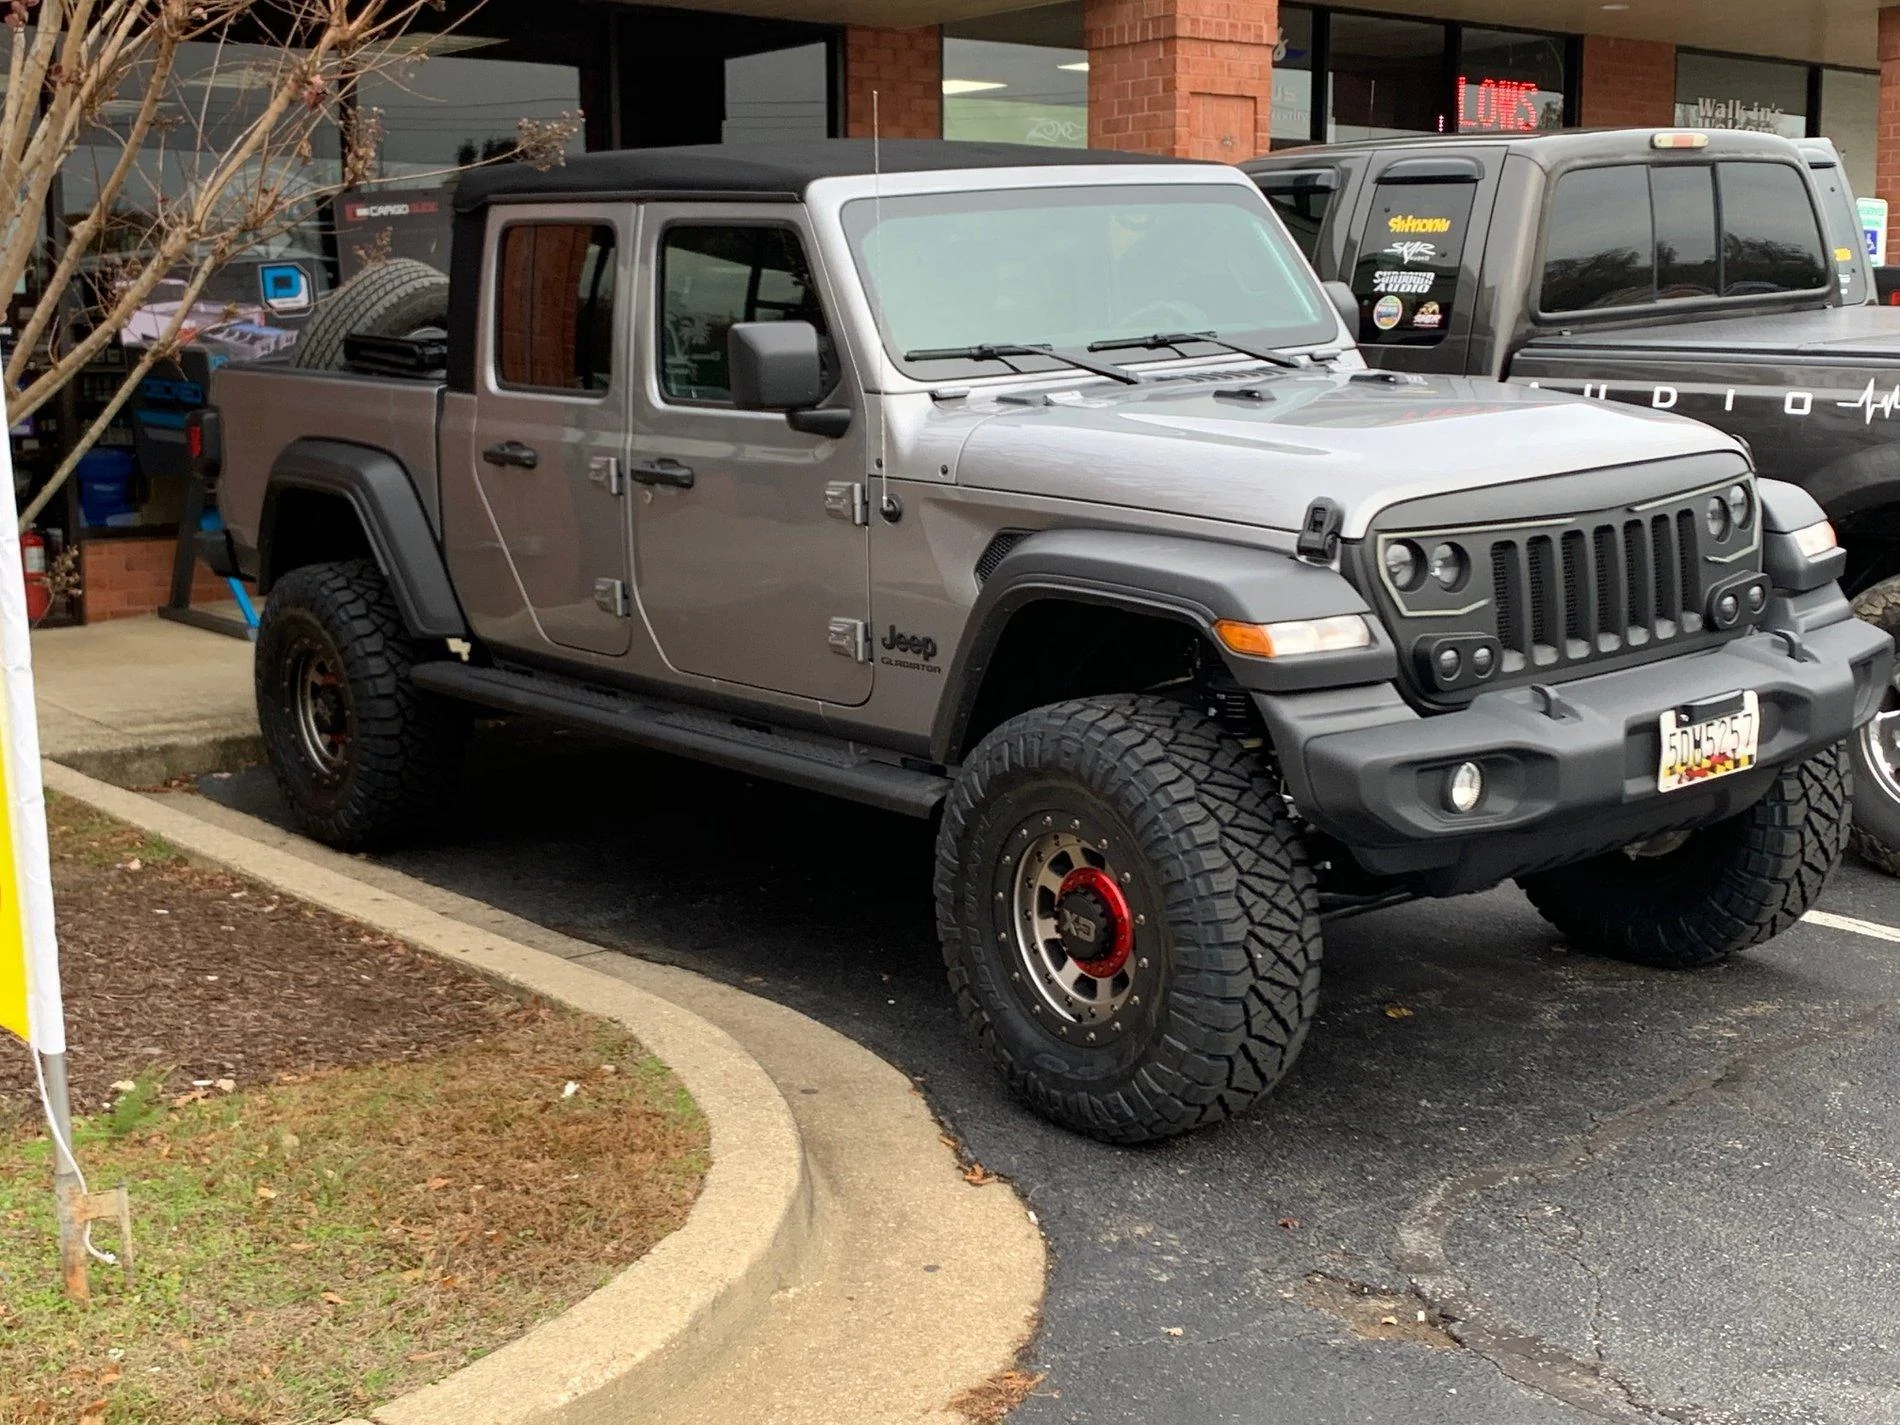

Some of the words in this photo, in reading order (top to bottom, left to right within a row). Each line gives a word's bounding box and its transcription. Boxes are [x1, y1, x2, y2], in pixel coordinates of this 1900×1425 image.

[1373, 283, 1431, 294] AUDIO
[1530, 382, 1813, 415] UDIO
[881, 624, 938, 662] Jeep
[880, 656, 942, 674] GLADIATOR
